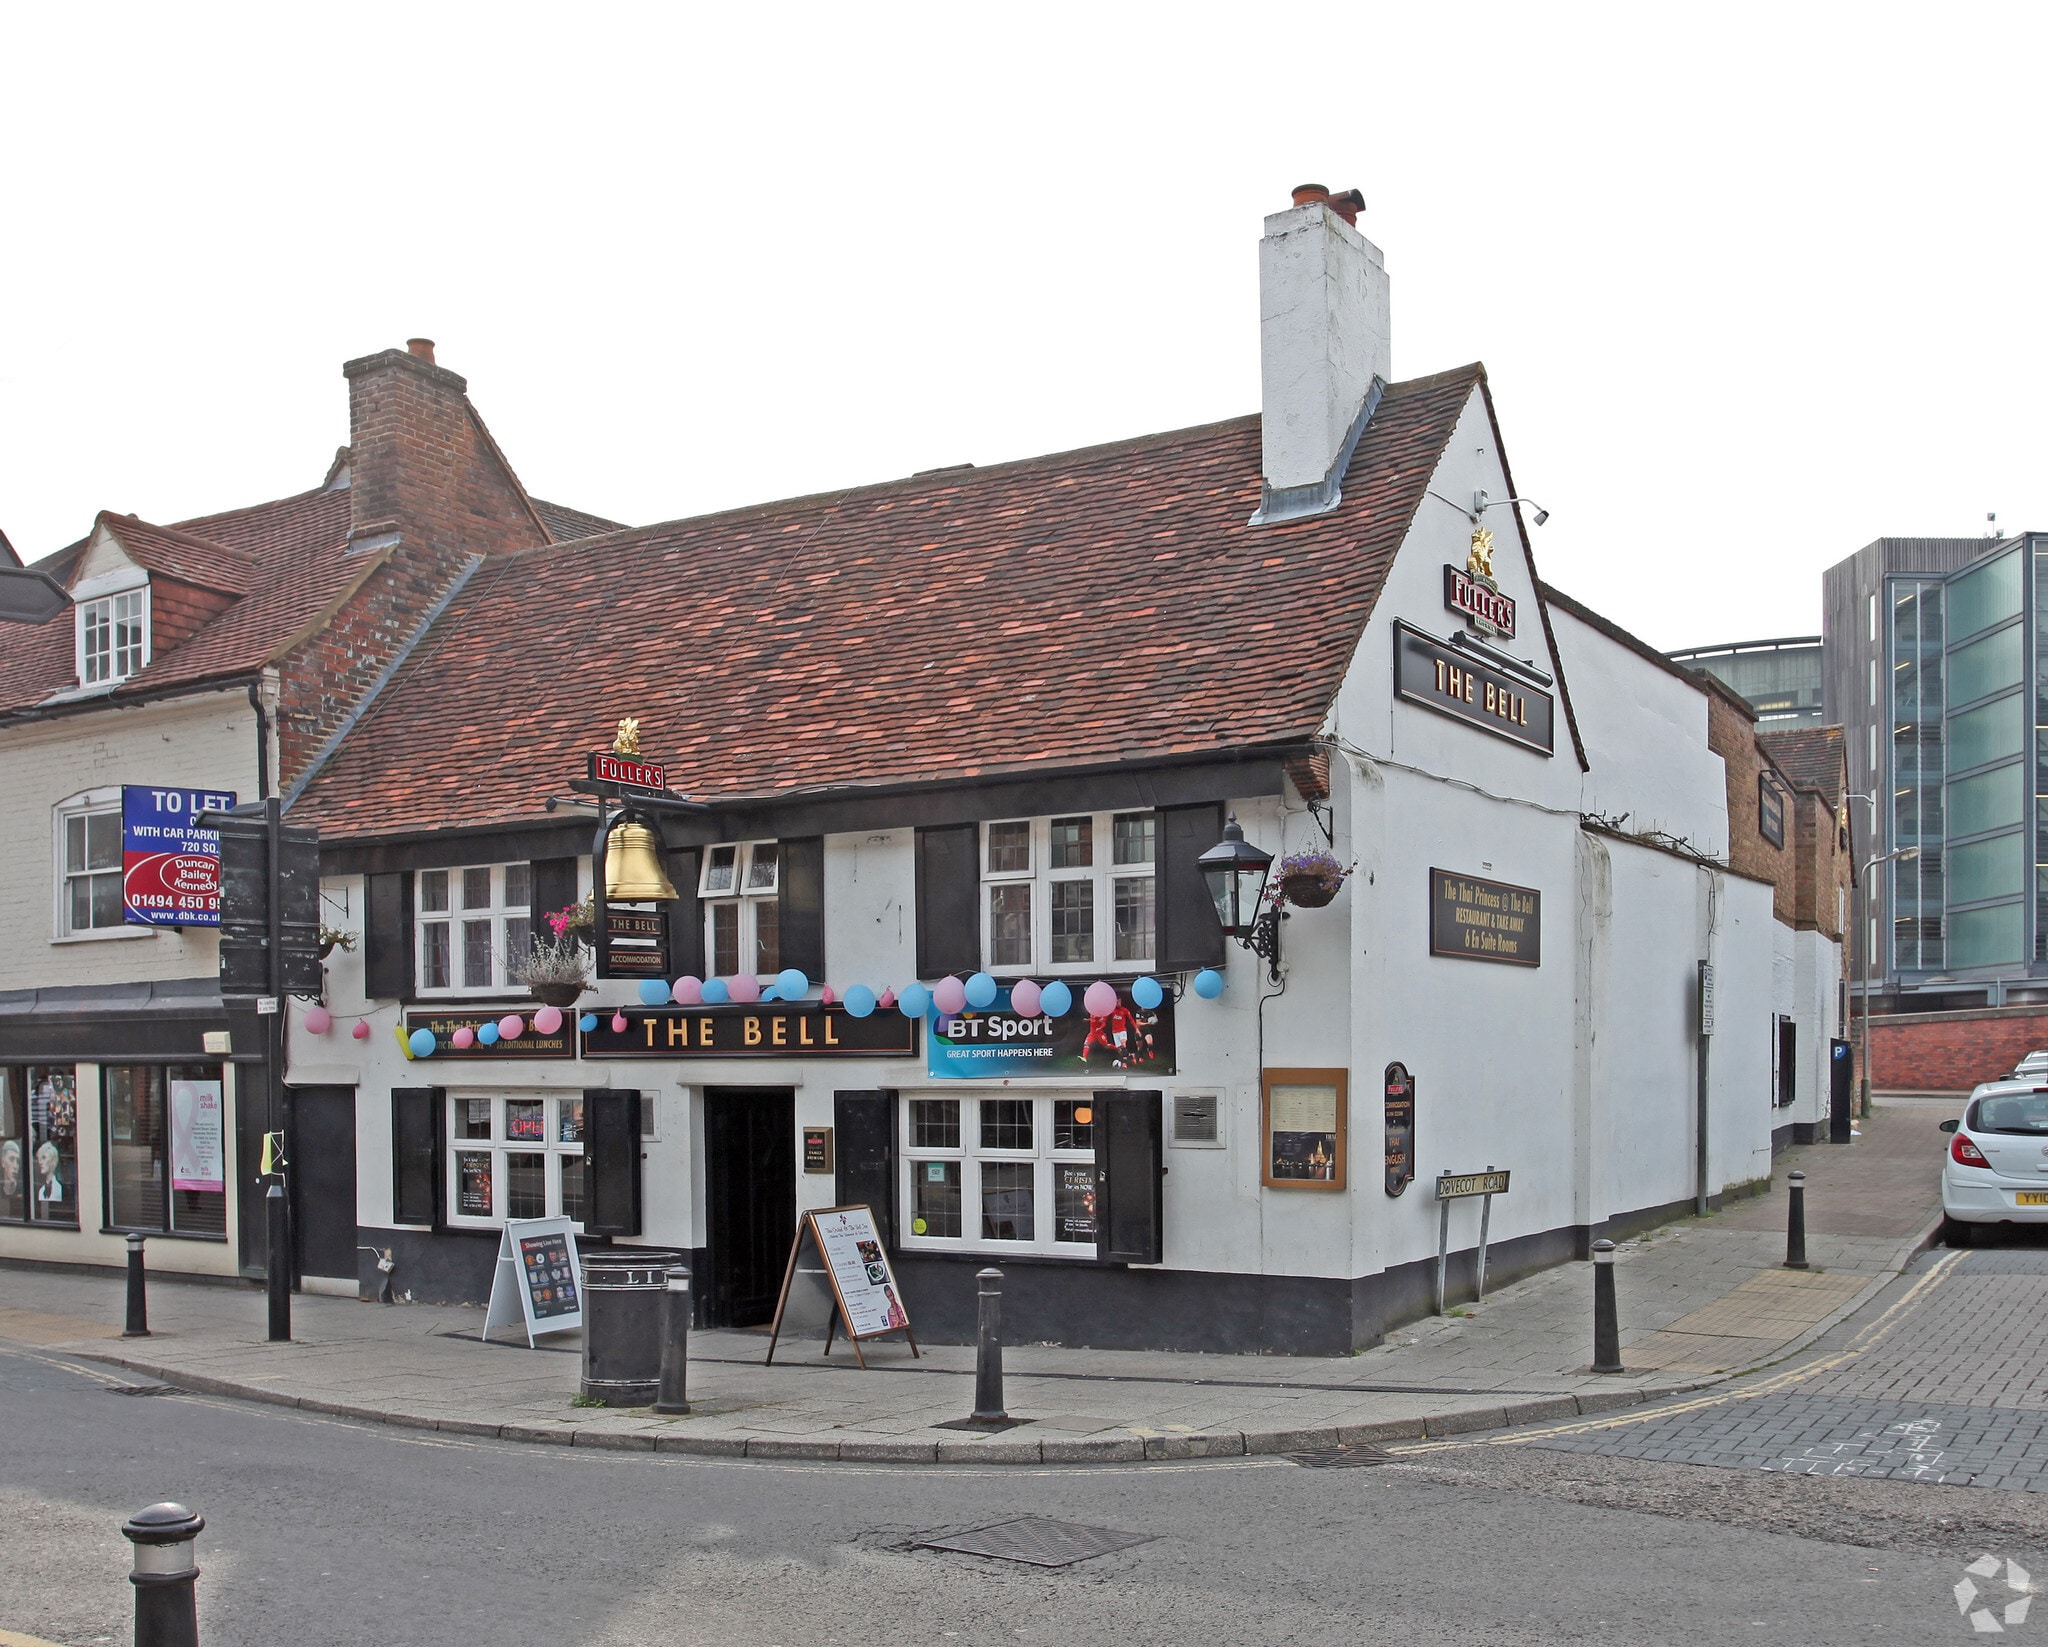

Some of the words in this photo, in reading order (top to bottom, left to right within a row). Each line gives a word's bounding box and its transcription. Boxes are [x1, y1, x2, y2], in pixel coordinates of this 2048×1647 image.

[1455, 575, 1513, 628] FULLER'S
[1434, 659, 1474, 704] THE
[1484, 681, 1528, 726] BELL
[600, 758, 661, 786] FULLER'S
[152, 791, 182, 813] TO
[190, 793, 230, 814] LET
[133, 826, 160, 838] WITH
[163, 827, 184, 839] CAR
[181, 841, 200, 852] 720
[175, 859, 215, 871] Duncan
[181, 870, 212, 882] Bailey
[174, 877, 217, 890] Kennedy
[132, 894, 174, 908] 01494
[178, 896, 204, 909] 450
[1444, 880, 1456, 900] The
[1460, 882, 1473, 903] Thai
[1475, 886, 1500, 908] Princess
[1502, 893, 1509, 912] @
[1511, 892, 1521, 913] The
[1522, 895, 1534, 915] Bell
[612, 919, 630, 929] THE
[635, 920, 656, 931] BELL
[1455, 907, 1490, 928] RESTAURANT
[1491, 913, 1495, 928] &
[1496, 914, 1509, 931] TAKE
[1509, 916, 1525, 932] AWAY
[1465, 928, 1470, 948] 6
[1471, 930, 1480, 949] En
[1481, 931, 1497, 951] Suite
[1497, 934, 1518, 953] Rooms
[610, 955, 661, 964] ACCOMMODATION
[431, 1020, 445, 1033] The
[643, 1018, 714, 1046] THE
[744, 1016, 840, 1045] BELL
[947, 1018, 984, 1038] BT
[987, 1015, 1053, 1040] Sport
[496, 1040, 534, 1049] TRADITIONAL
[535, 1040, 562, 1049] LUNCHES
[1834, 1046, 1843, 1057] P
[947, 1050, 970, 1059] GREAT
[971, 1049, 996, 1058] SPORT
[997, 1048, 1032, 1058] HAPPENS
[1033, 1047, 1053, 1057] HERE
[1440, 1178, 1476, 1195] DOVECOT
[1483, 1175, 1505, 1190] ROAD
